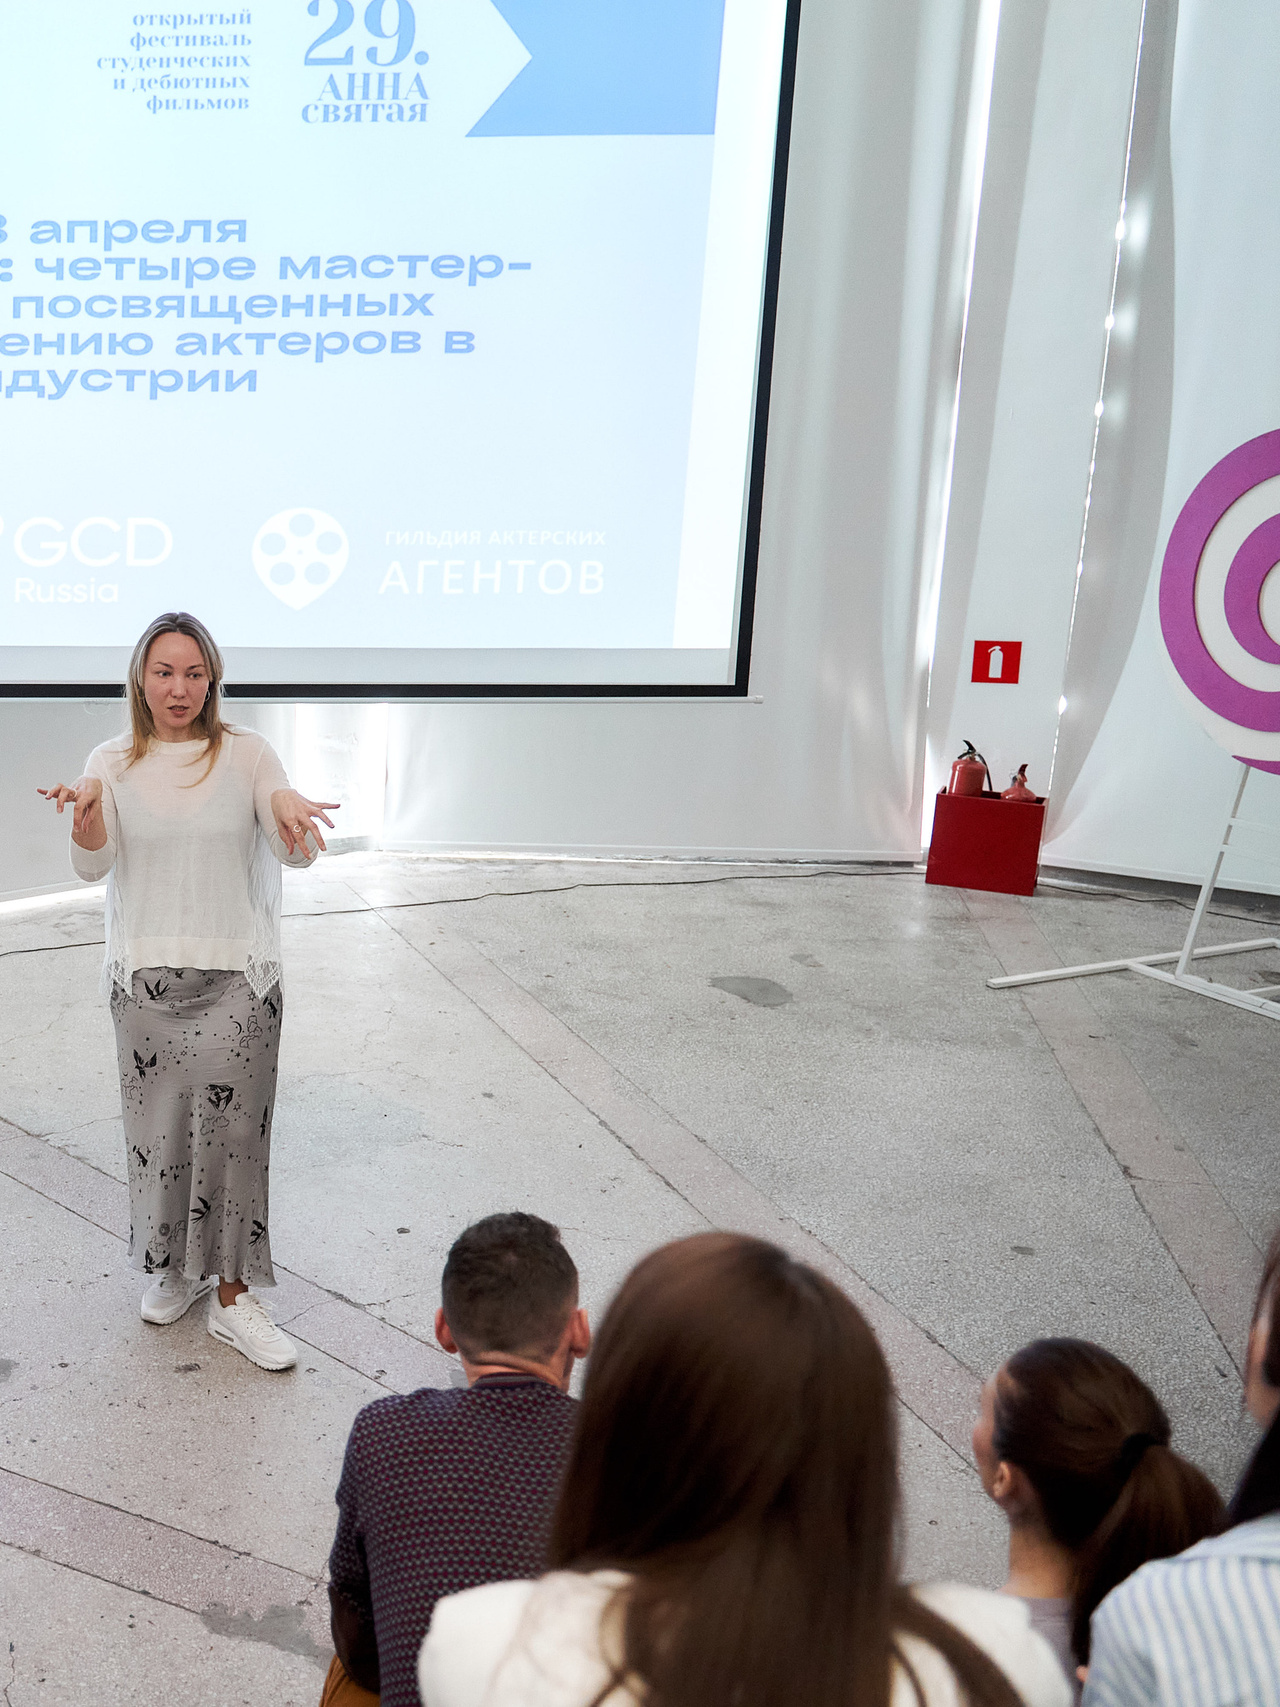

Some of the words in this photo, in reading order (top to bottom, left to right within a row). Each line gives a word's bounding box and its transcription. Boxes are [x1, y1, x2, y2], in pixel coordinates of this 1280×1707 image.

[132, 9, 252, 30] открытый
[304, 0, 429, 67] 29.
[130, 32, 252, 51] фестиваль
[97, 55, 251, 73] студенческих
[113, 78, 126, 90] и
[132, 74, 251, 92] дебютных
[317, 72, 430, 101] АННА
[146, 95, 250, 114] фильмов
[30, 219, 247, 252] апреля
[35, 256, 257, 289] четыре
[279, 254, 532, 287] мастер-
[13, 293, 435, 325] посвященных
[176, 330, 422, 363] актеров
[445, 331, 476, 354] в
[14, 516, 173, 568] GCD
[385, 530, 481, 549] ГИЛЬДИЯ
[488, 530, 606, 546] АКТЕРСКИХ
[14, 577, 119, 603] Russia
[378, 559, 605, 595] АГЕНТОВ
